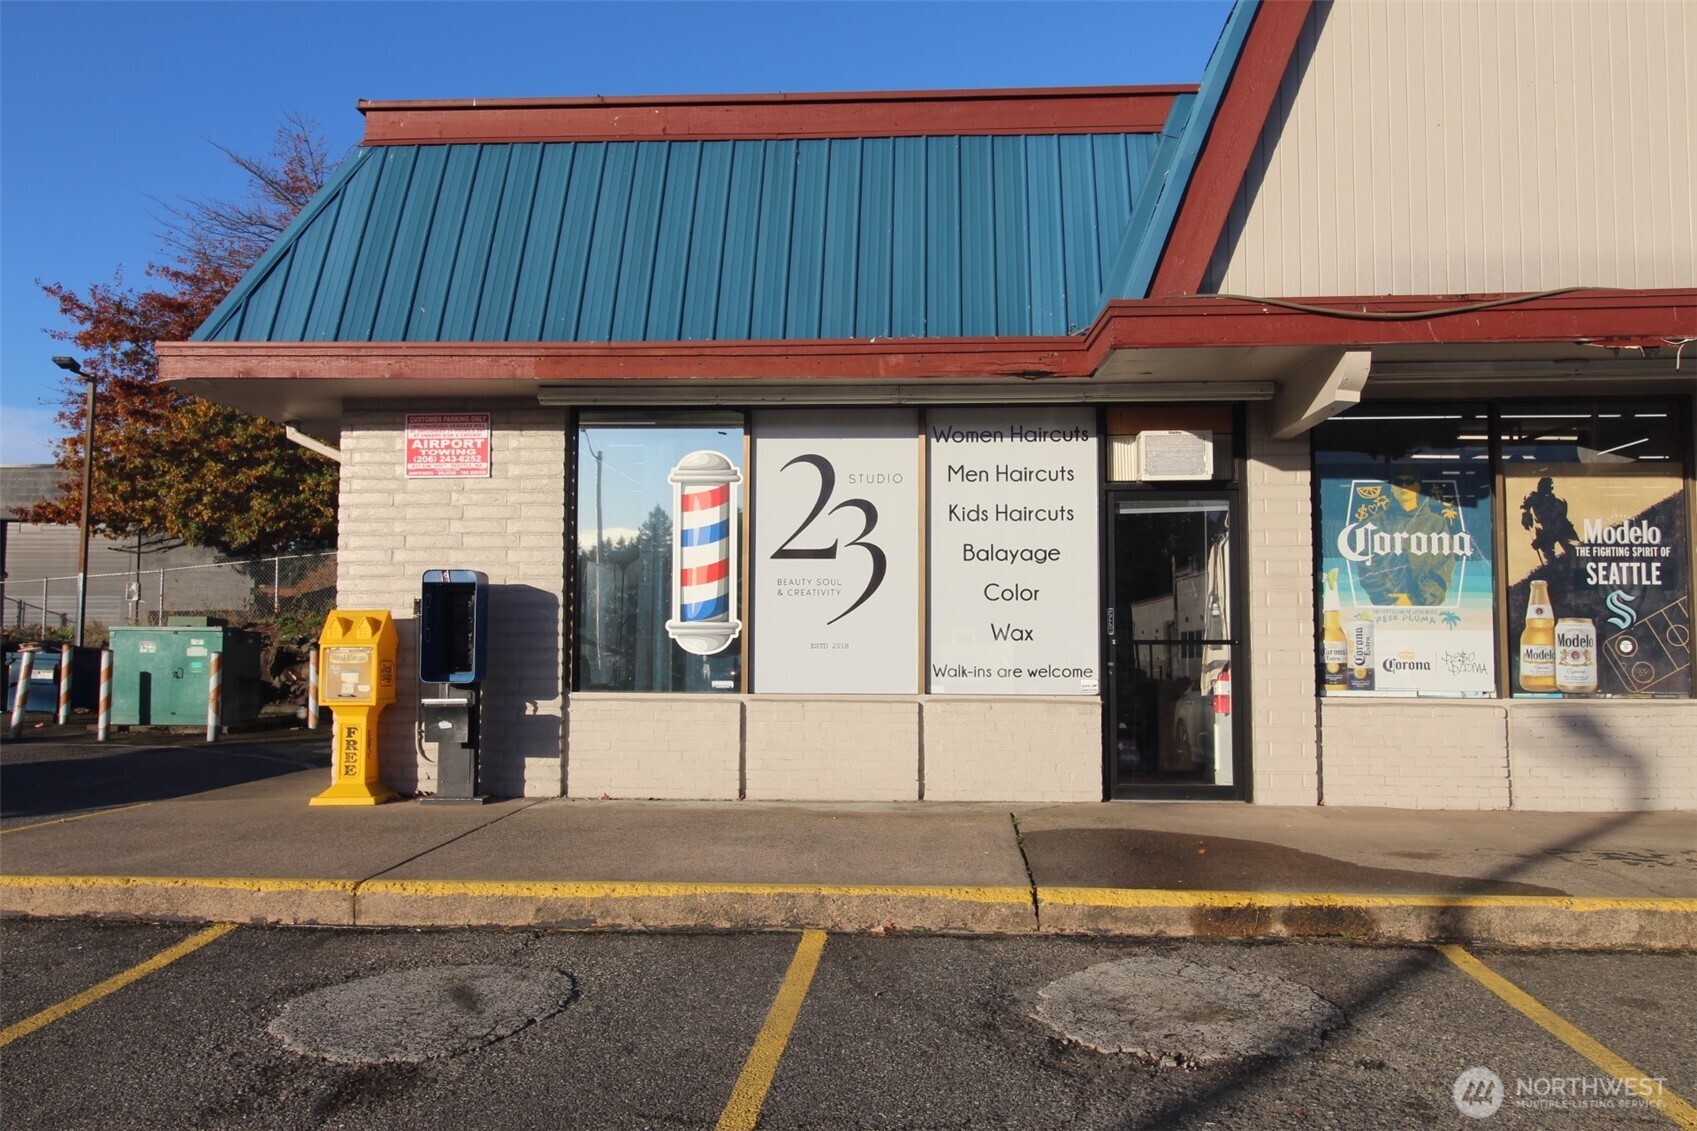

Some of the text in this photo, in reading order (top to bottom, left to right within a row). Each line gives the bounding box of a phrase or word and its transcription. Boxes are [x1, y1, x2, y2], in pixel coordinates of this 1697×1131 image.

[932, 425, 1089, 443] Women Haircuts
[411, 439, 485, 449] AIRPORT
[849, 474, 904, 484] STUDIO
[947, 465, 1075, 482] Men Haircuts
[948, 504, 1075, 522] Kids Haircuts
[1583, 519, 1662, 545] Modelo
[1337, 522, 1473, 566] Corona
[1575, 546, 1671, 557] THE FIGHTING SPIRIT OF
[963, 544, 1061, 565] Balayage
[1586, 562, 1662, 586] SEATTLE
[777, 588, 842, 597] & CREATIVITY
[983, 583, 1040, 602] Color
[1376, 614, 1436, 625] PESO PLUMA
[990, 624, 1034, 642] Wax
[1557, 633, 1594, 648] Modelo
[1354, 627, 1366, 666] Corona
[932, 664, 1093, 678] Walk-ins are welcome
[1382, 658, 1431, 674] Corona
[344, 727, 358, 776] FREE
